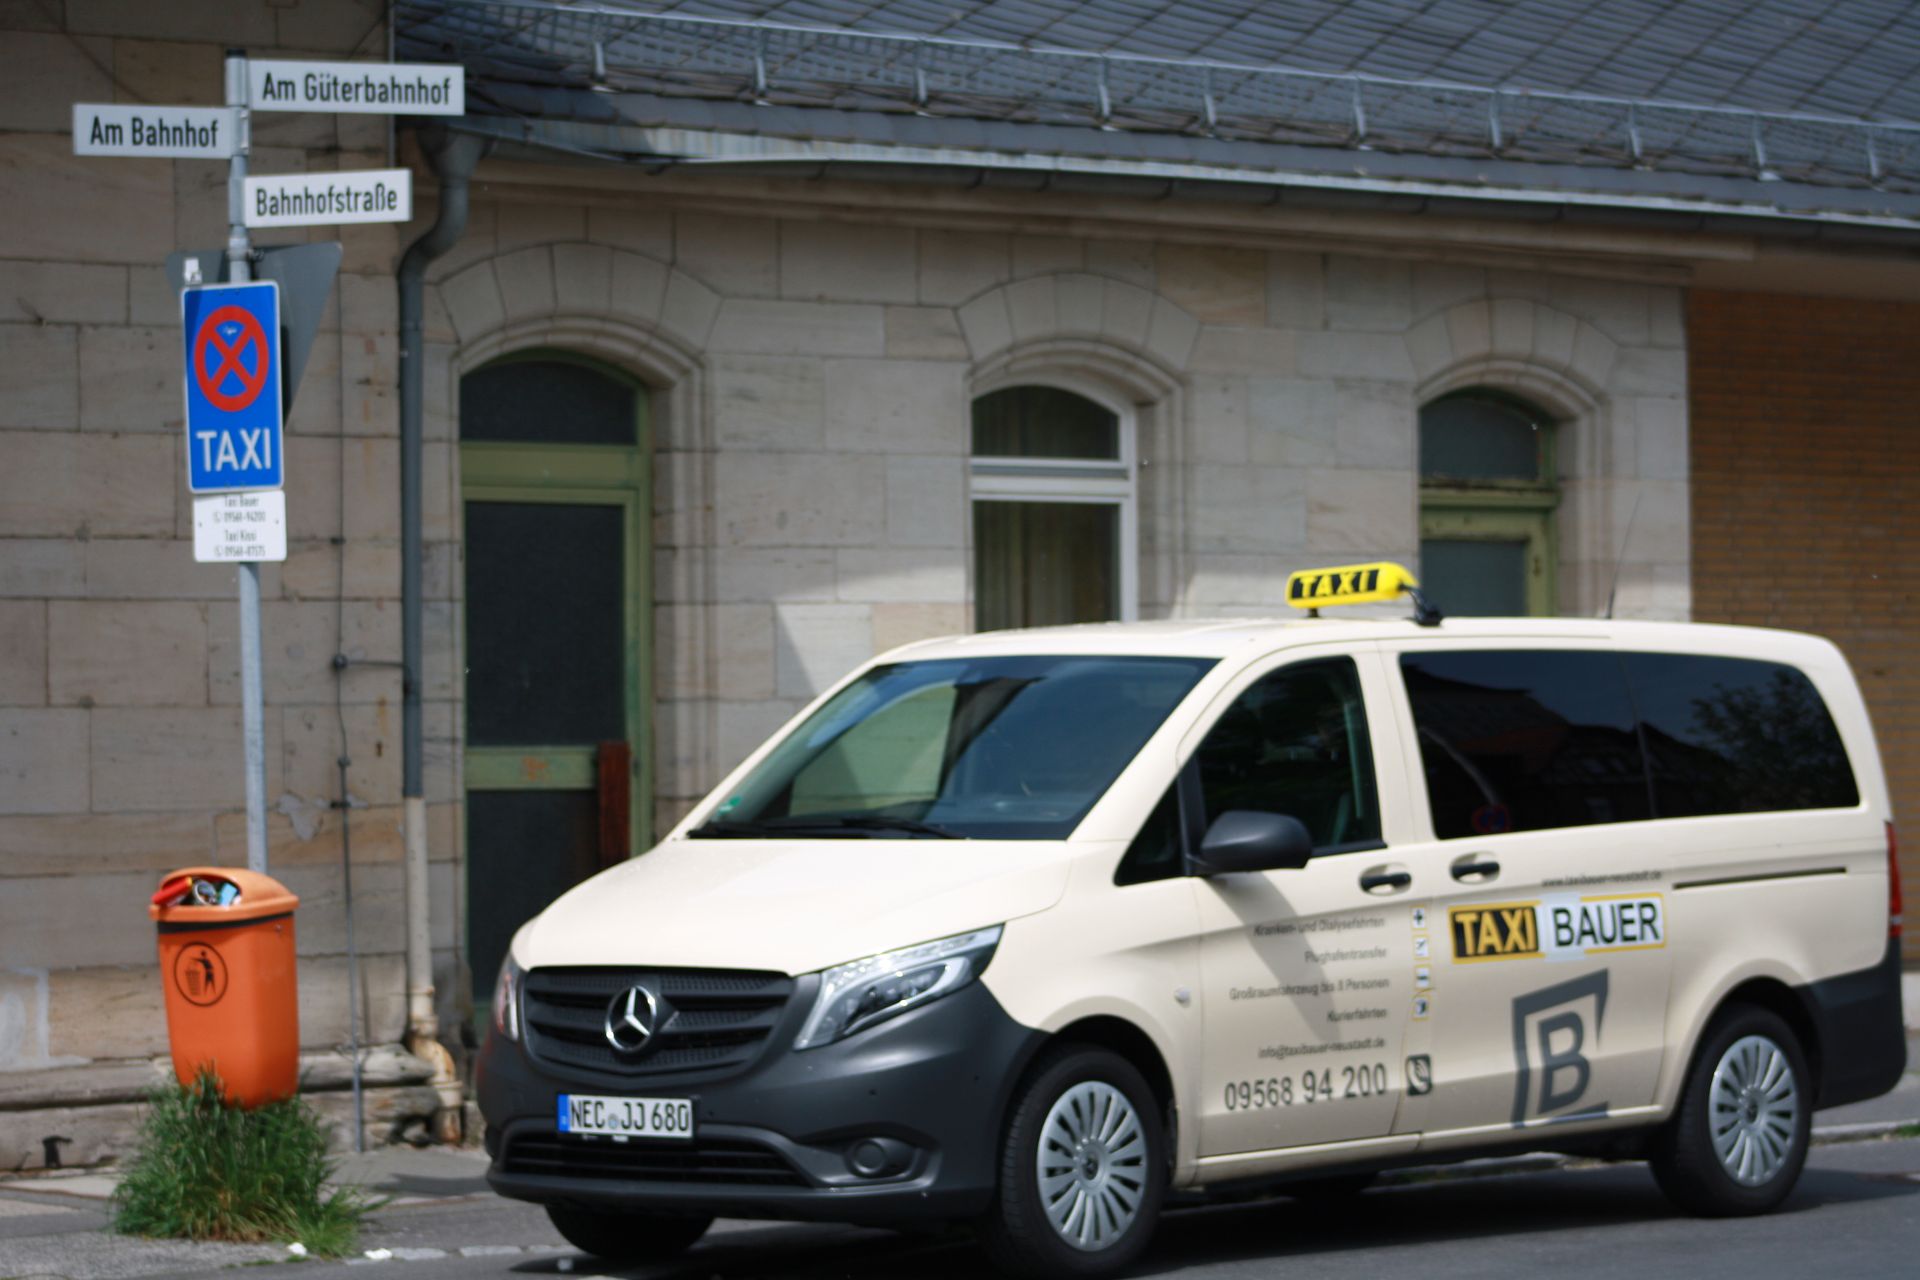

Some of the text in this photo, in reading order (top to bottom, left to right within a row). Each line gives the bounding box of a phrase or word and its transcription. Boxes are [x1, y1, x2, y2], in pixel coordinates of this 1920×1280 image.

[263, 72, 452, 105] Am Güterbahnhof
[90, 115, 219, 148] Am Bahnhof
[255, 183, 397, 216] Bahnhofstraße
[196, 427, 272, 472] TAXI
[224, 494, 260, 508] Taxi Bauer
[225, 529, 239, 542] Taxi
[1299, 571, 1369, 599] TAXI
[1253, 916, 1385, 937] Kranken- und Dialysefahrten
[1455, 902, 1660, 956] TAXI BAUER
[1304, 945, 1387, 965] Flughafentransfer
[1229, 981, 1319, 1000] Großraumfahrzeug
[1320, 980, 1335, 993] bis
[1346, 977, 1390, 991] Personen
[1327, 1008, 1387, 1023] Kurierfahrten
[1225, 1063, 1387, 1110] 09568 94 200
[570, 1100, 689, 1131] NEC JJ 680
